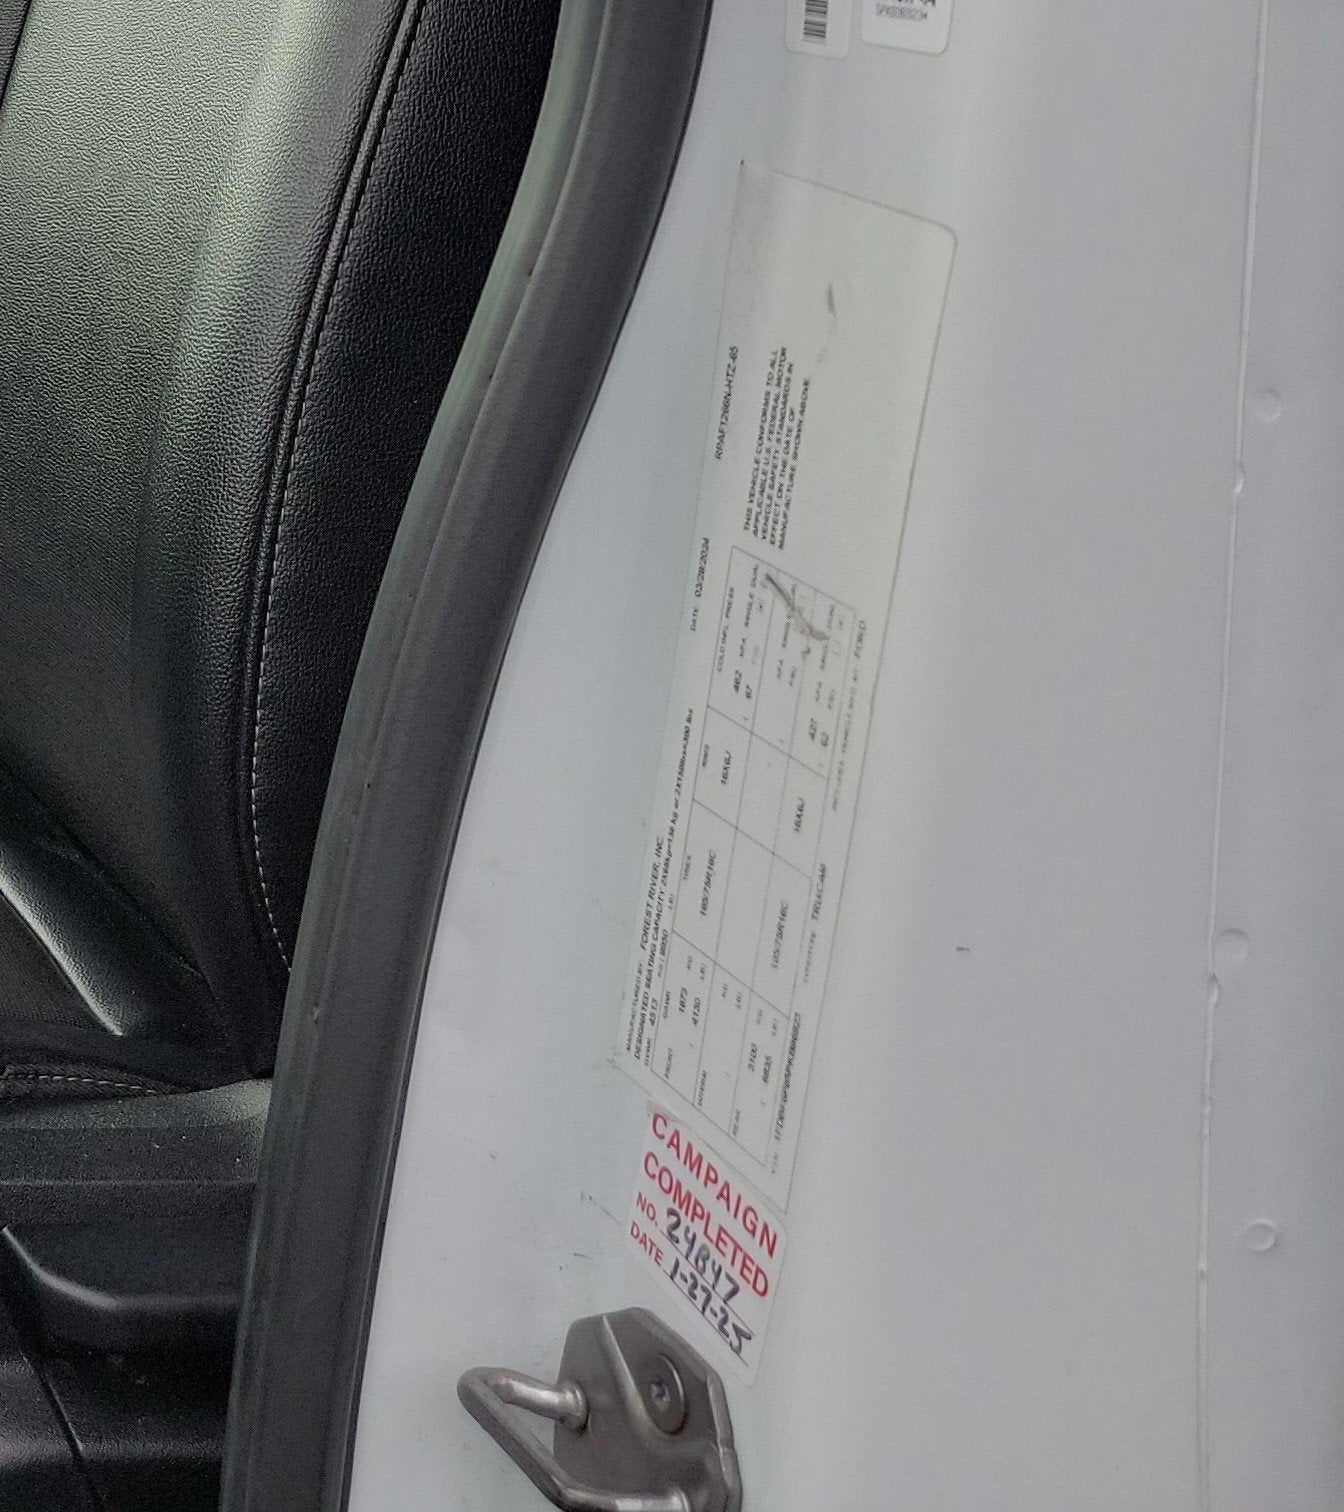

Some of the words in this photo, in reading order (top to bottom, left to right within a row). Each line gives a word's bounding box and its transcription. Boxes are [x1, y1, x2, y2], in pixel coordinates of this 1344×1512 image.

[639, 900, 653, 952] FOREST
[636, 1192, 658, 1226] NO.
[652, 1113, 777, 1257] CAMPAIGN
[630, 1220, 662, 1266] DATE
[644, 1151, 768, 1297] COMPLETED
